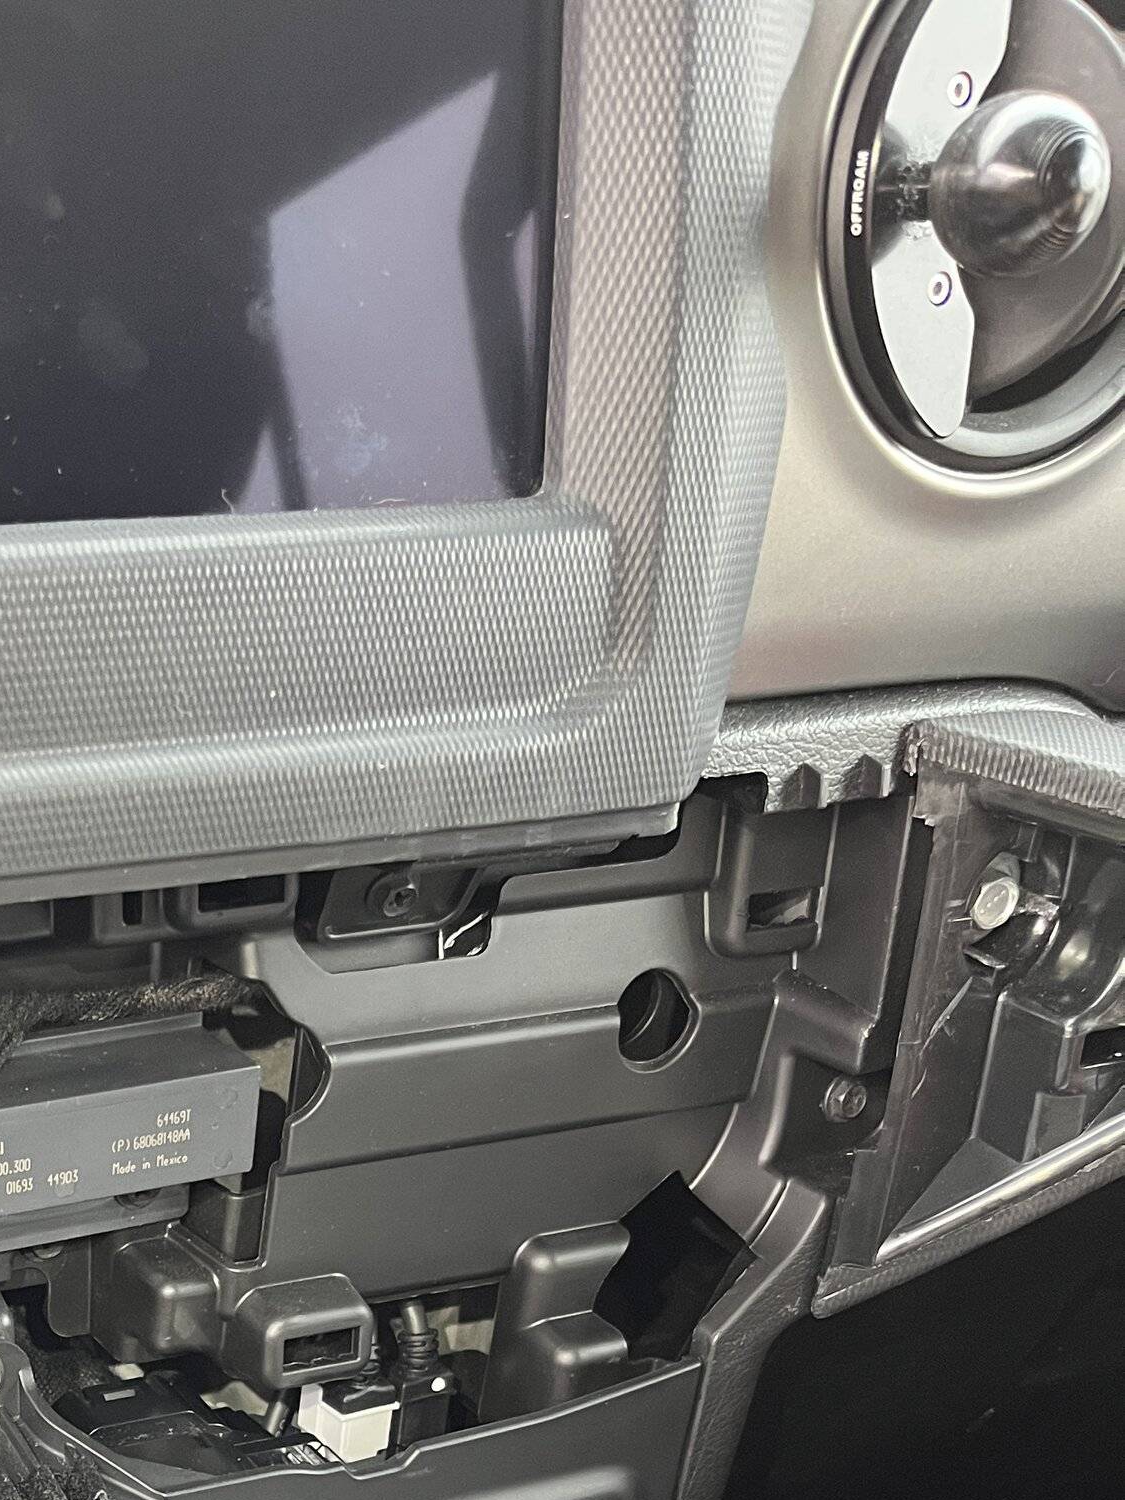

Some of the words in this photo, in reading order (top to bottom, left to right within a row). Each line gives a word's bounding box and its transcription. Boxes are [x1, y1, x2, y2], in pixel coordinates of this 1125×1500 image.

[850, 151, 869, 236] OFFROAM
[112, 1160, 136, 1175] Made
[142, 1157, 151, 1170] in
[156, 1152, 188, 1167] Mexico
